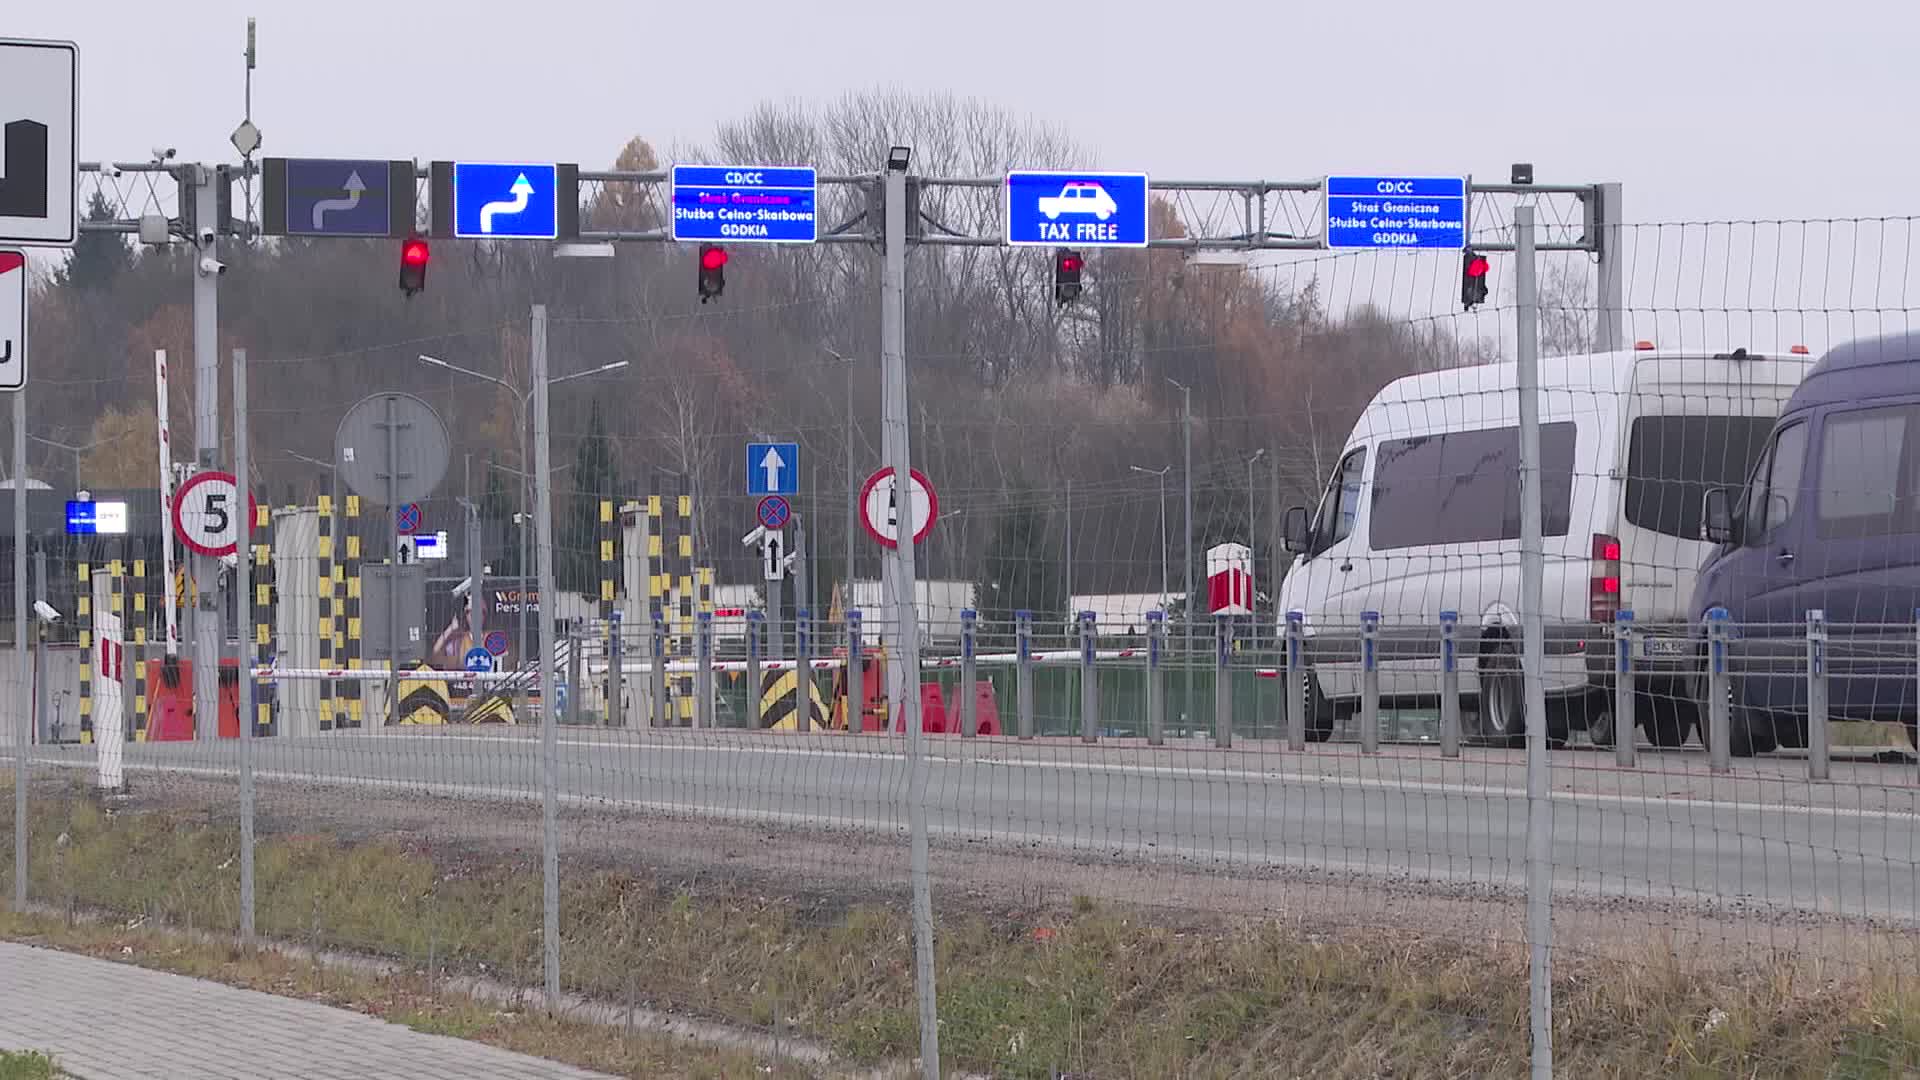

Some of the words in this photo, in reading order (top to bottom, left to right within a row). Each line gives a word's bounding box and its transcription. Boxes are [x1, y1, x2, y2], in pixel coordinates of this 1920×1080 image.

[725, 172, 763, 184] CD/CC
[1377, 182, 1413, 193] CD/CC
[1383, 201, 1440, 213] Graniczna
[1038, 223, 1070, 240] TAX
[1077, 223, 1118, 240] FREE
[204, 494, 229, 533] 5
[496, 603, 540, 613] Persna
